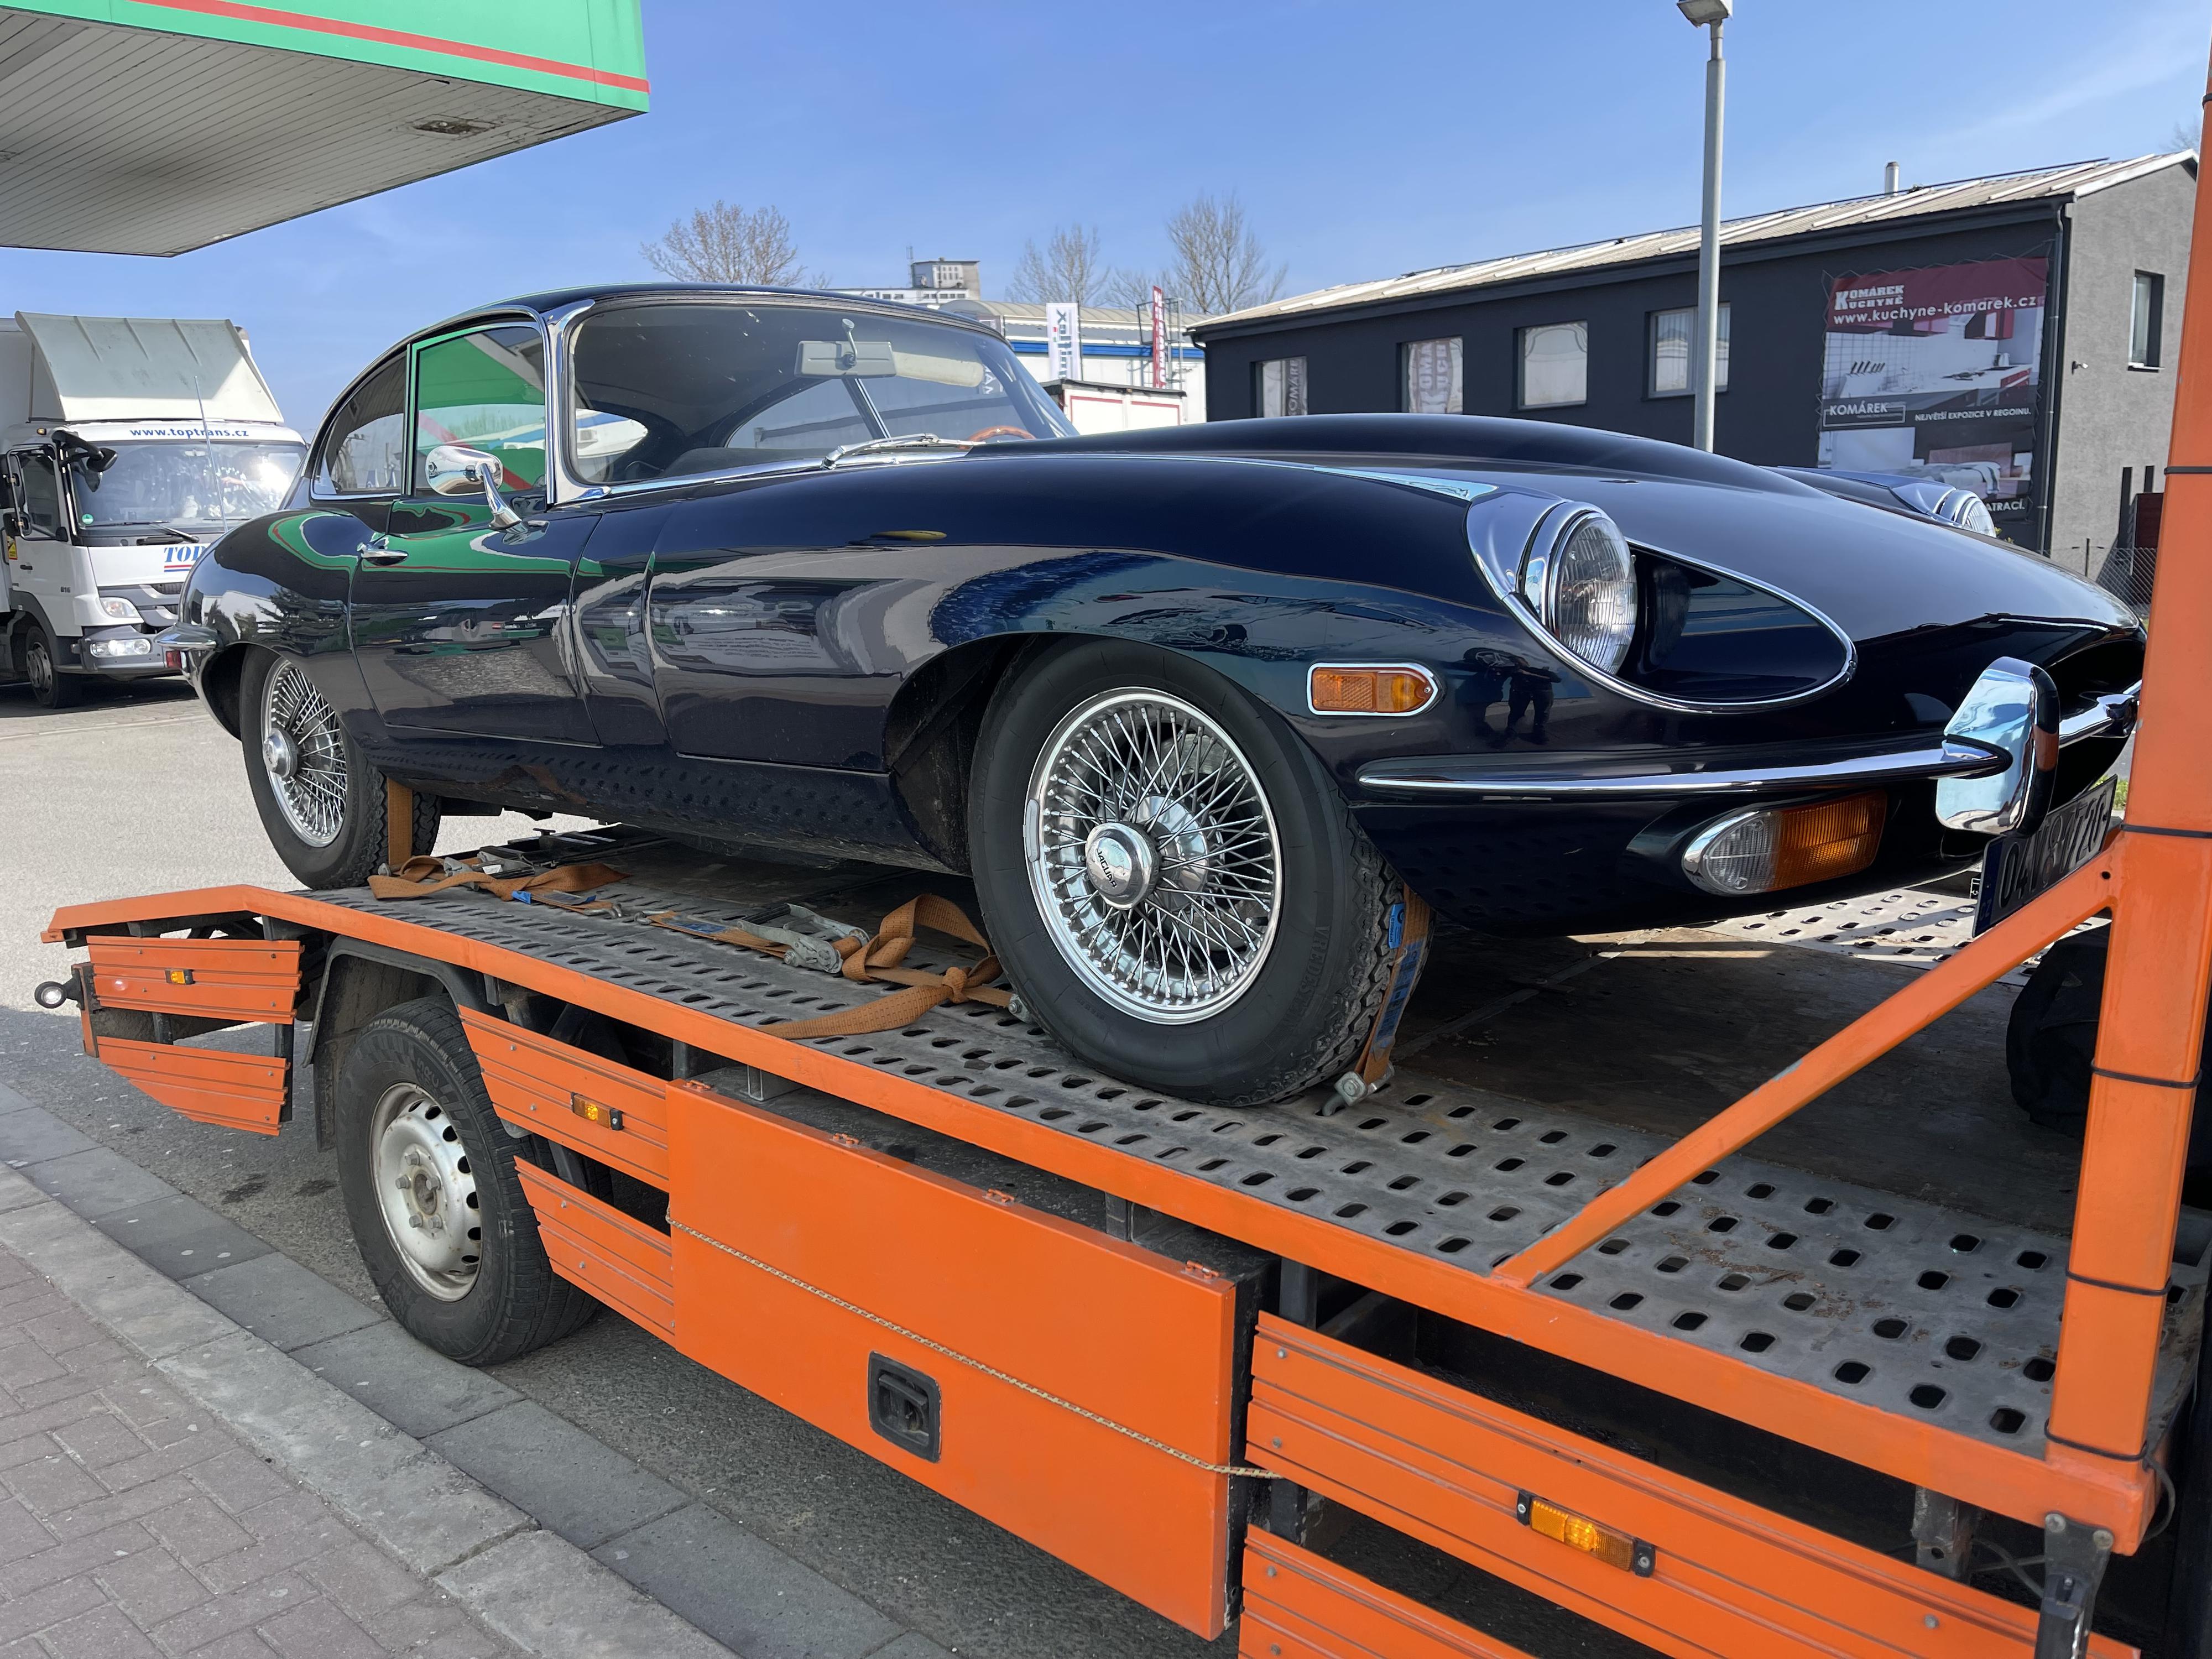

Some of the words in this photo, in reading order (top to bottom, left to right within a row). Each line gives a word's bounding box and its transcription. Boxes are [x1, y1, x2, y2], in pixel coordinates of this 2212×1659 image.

[1834, 296, 2037, 325] www.kuchyne-komarek.cz
[1829, 400, 1888, 415] KOMÁREK
[130, 429, 249, 439] www.toptrans.cz
[1986, 498, 2025, 512] ATRACÍ.
[1096, 848, 1117, 888] JAGUAR
